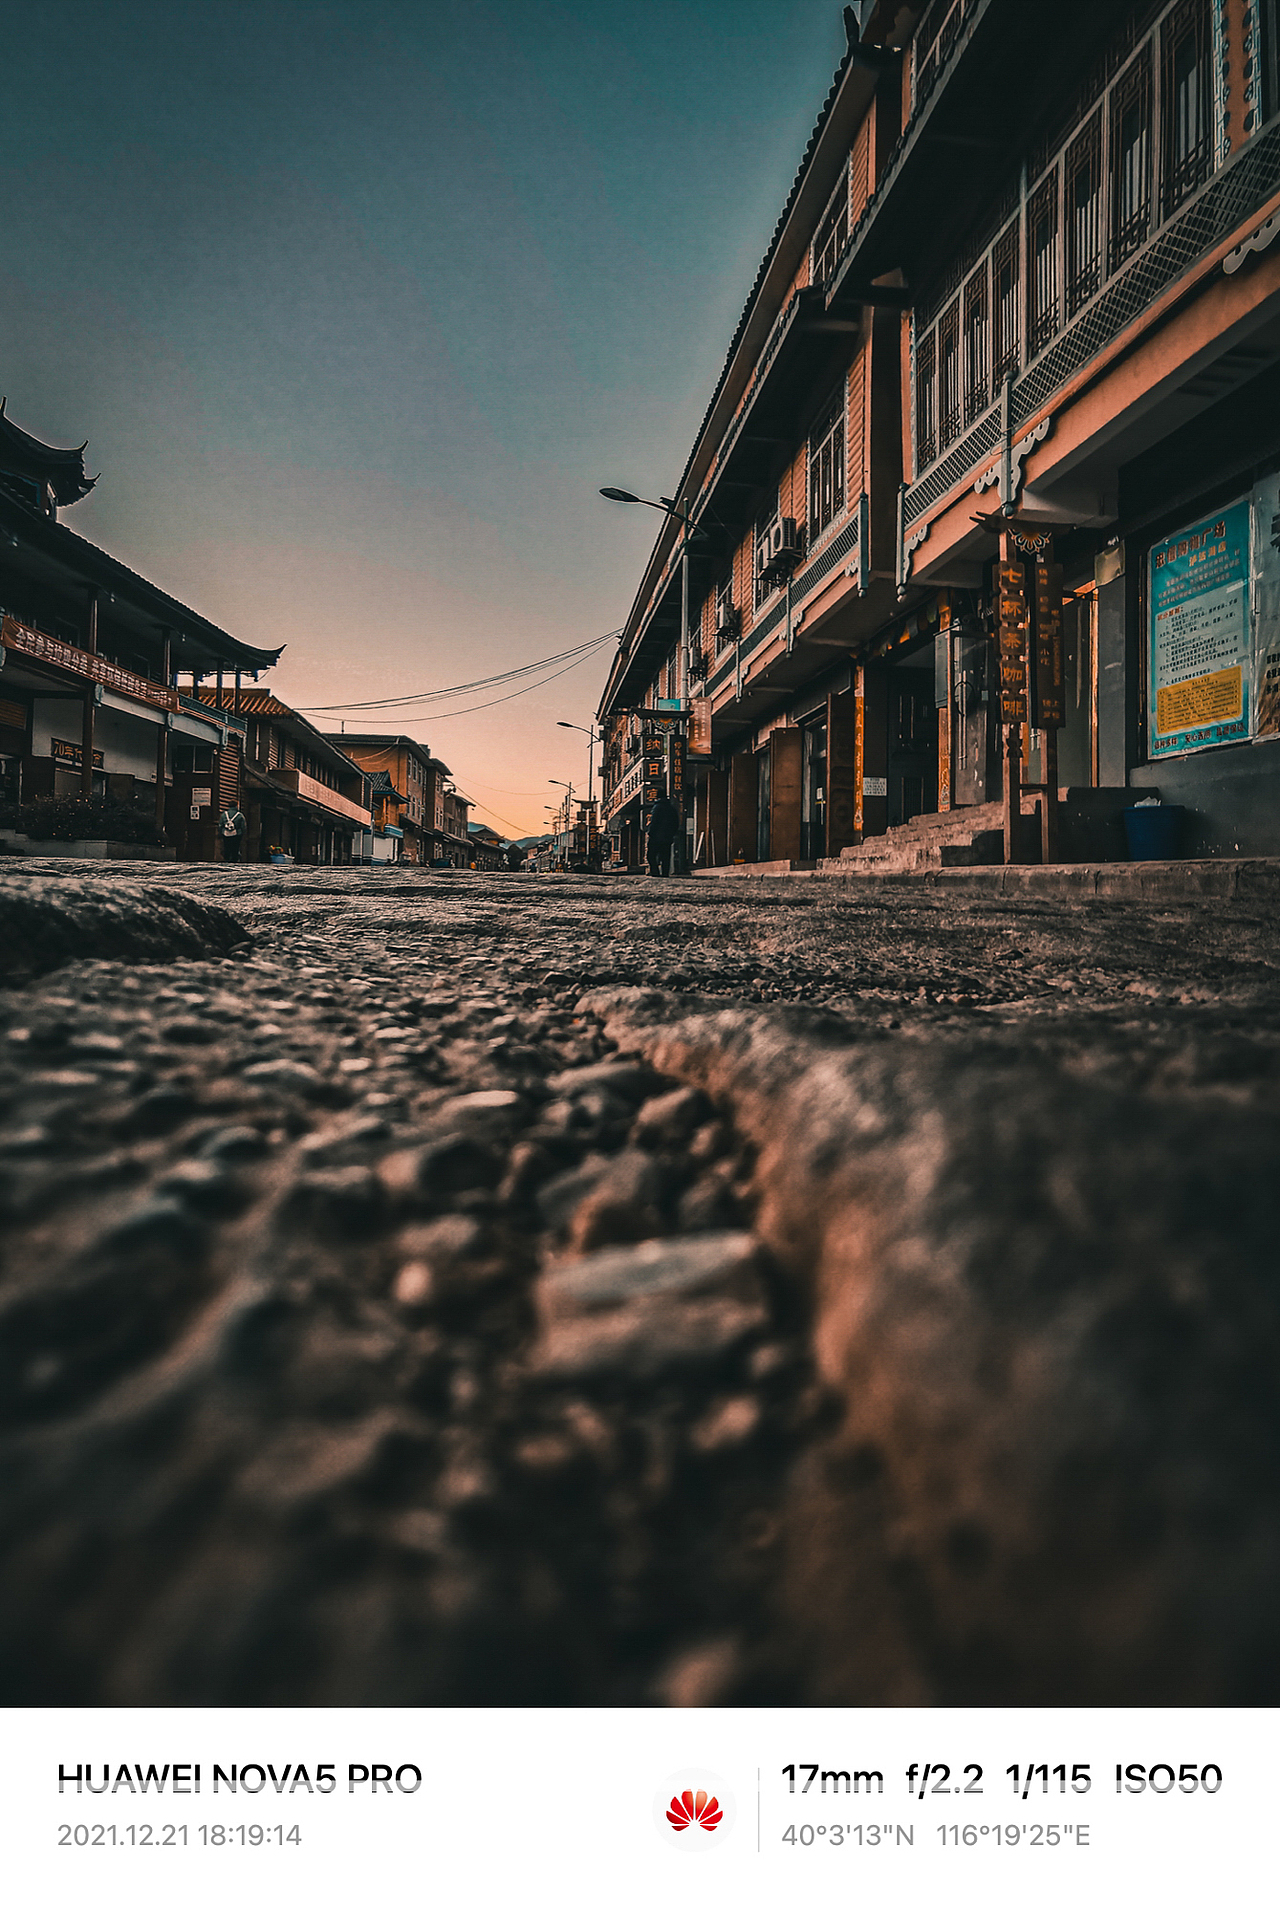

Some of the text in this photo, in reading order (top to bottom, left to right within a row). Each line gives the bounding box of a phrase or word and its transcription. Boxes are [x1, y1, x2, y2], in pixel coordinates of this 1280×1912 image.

[1002, 567, 1024, 716] 七杯茶咖啡
